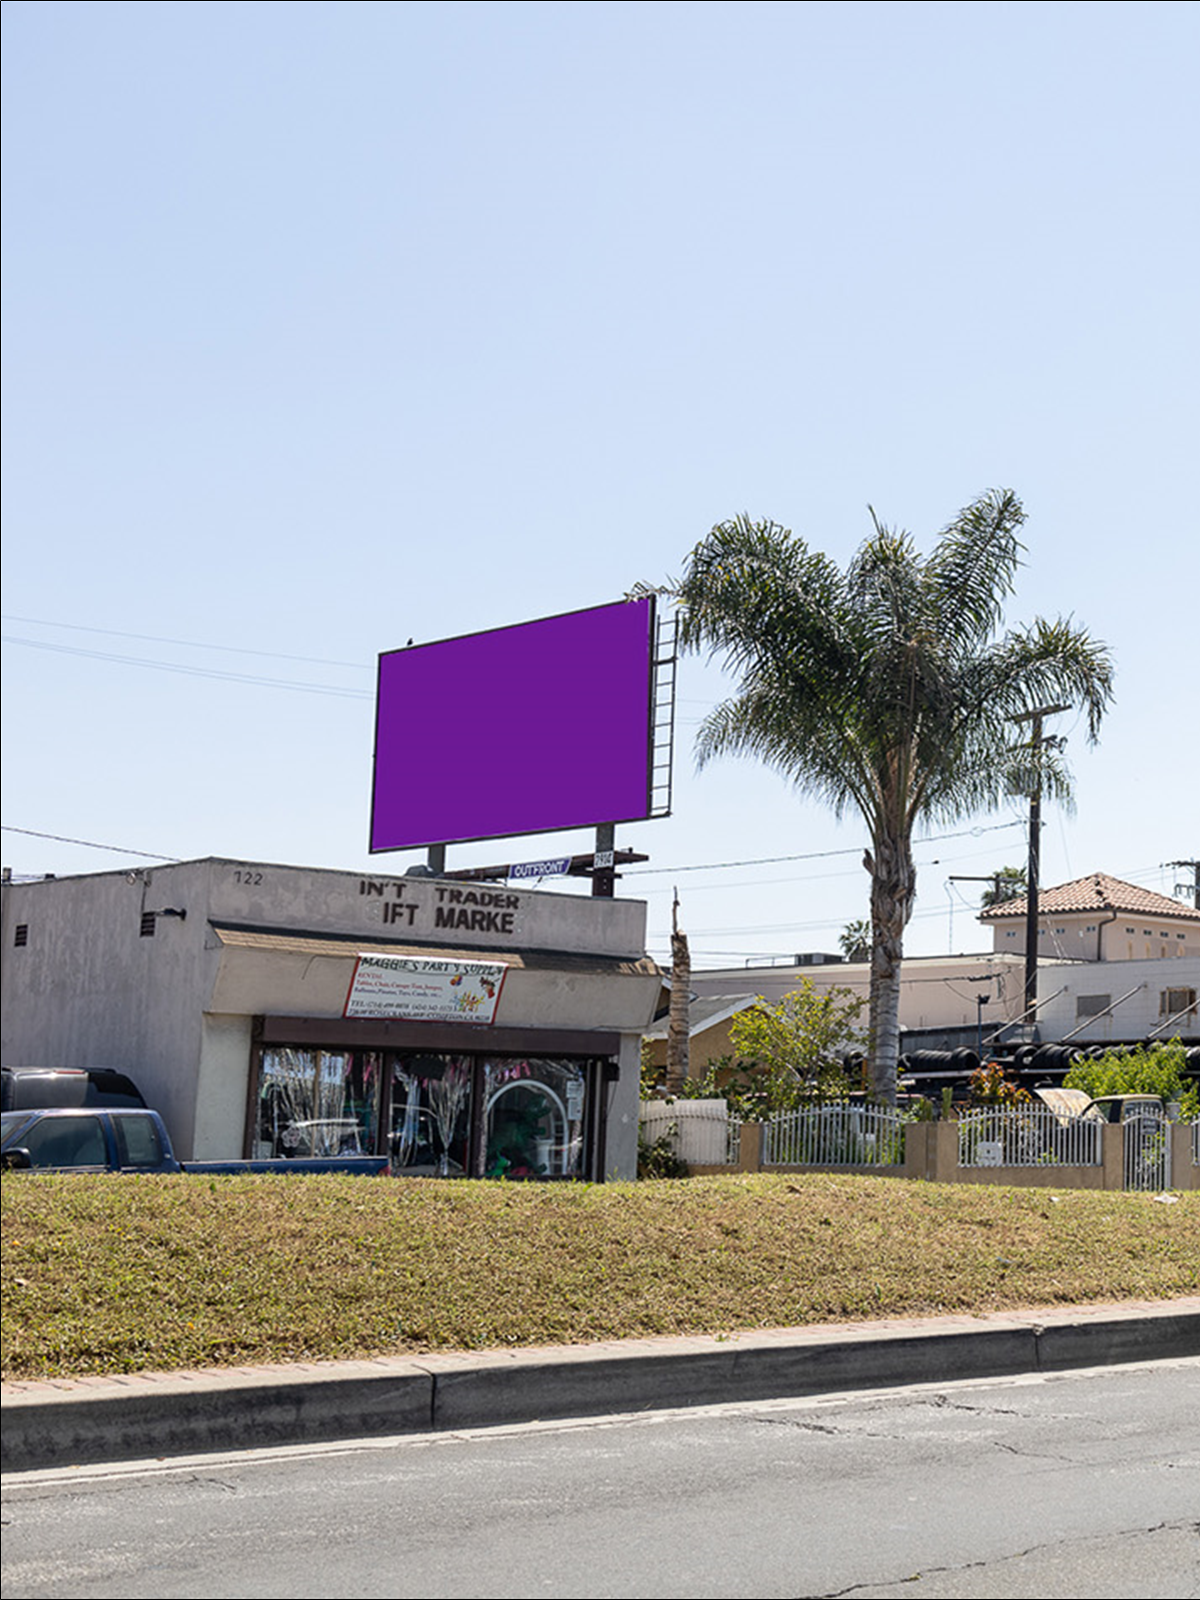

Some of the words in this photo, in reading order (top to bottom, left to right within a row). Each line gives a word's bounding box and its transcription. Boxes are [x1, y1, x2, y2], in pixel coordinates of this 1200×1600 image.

[234, 870, 264, 887] 722
[514, 861, 565, 876] OUTFRONT
[435, 887, 520, 910] TRADER
[382, 902, 419, 926] IFT
[435, 907, 515, 934] MARKE
